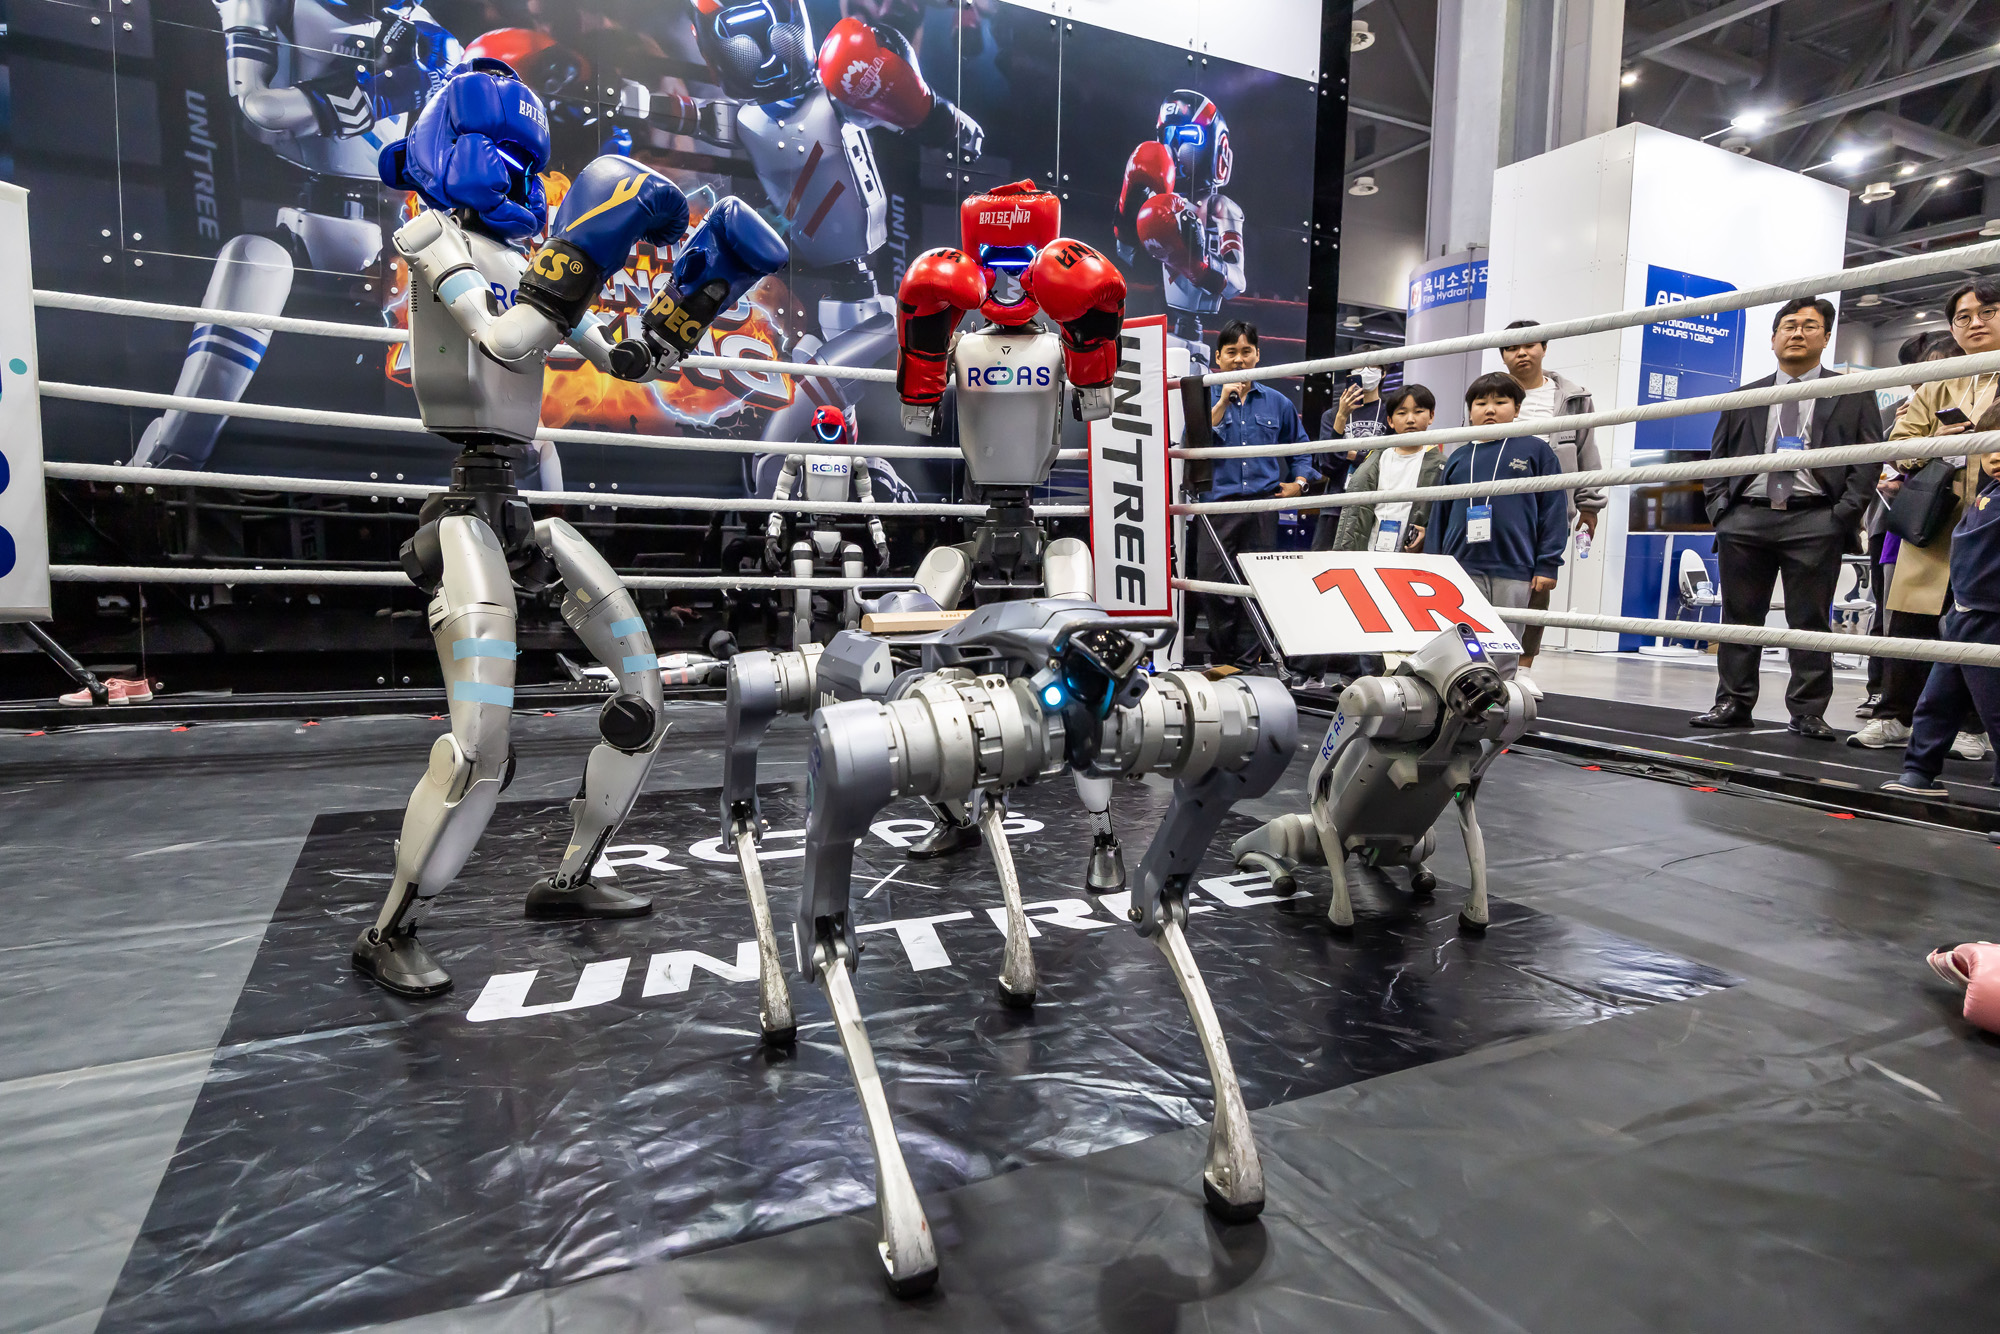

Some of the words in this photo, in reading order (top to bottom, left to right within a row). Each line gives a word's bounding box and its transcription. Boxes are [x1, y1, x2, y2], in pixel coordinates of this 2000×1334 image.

[184, 88, 220, 241] UNITREE
[979, 204, 1031, 230] BAISENNA
[1423, 294, 1435, 305] Fire
[1102, 335, 1153, 606] UNITREE
[1312, 567, 1495, 634] 1R
[466, 870, 1314, 1023] UNTREE
